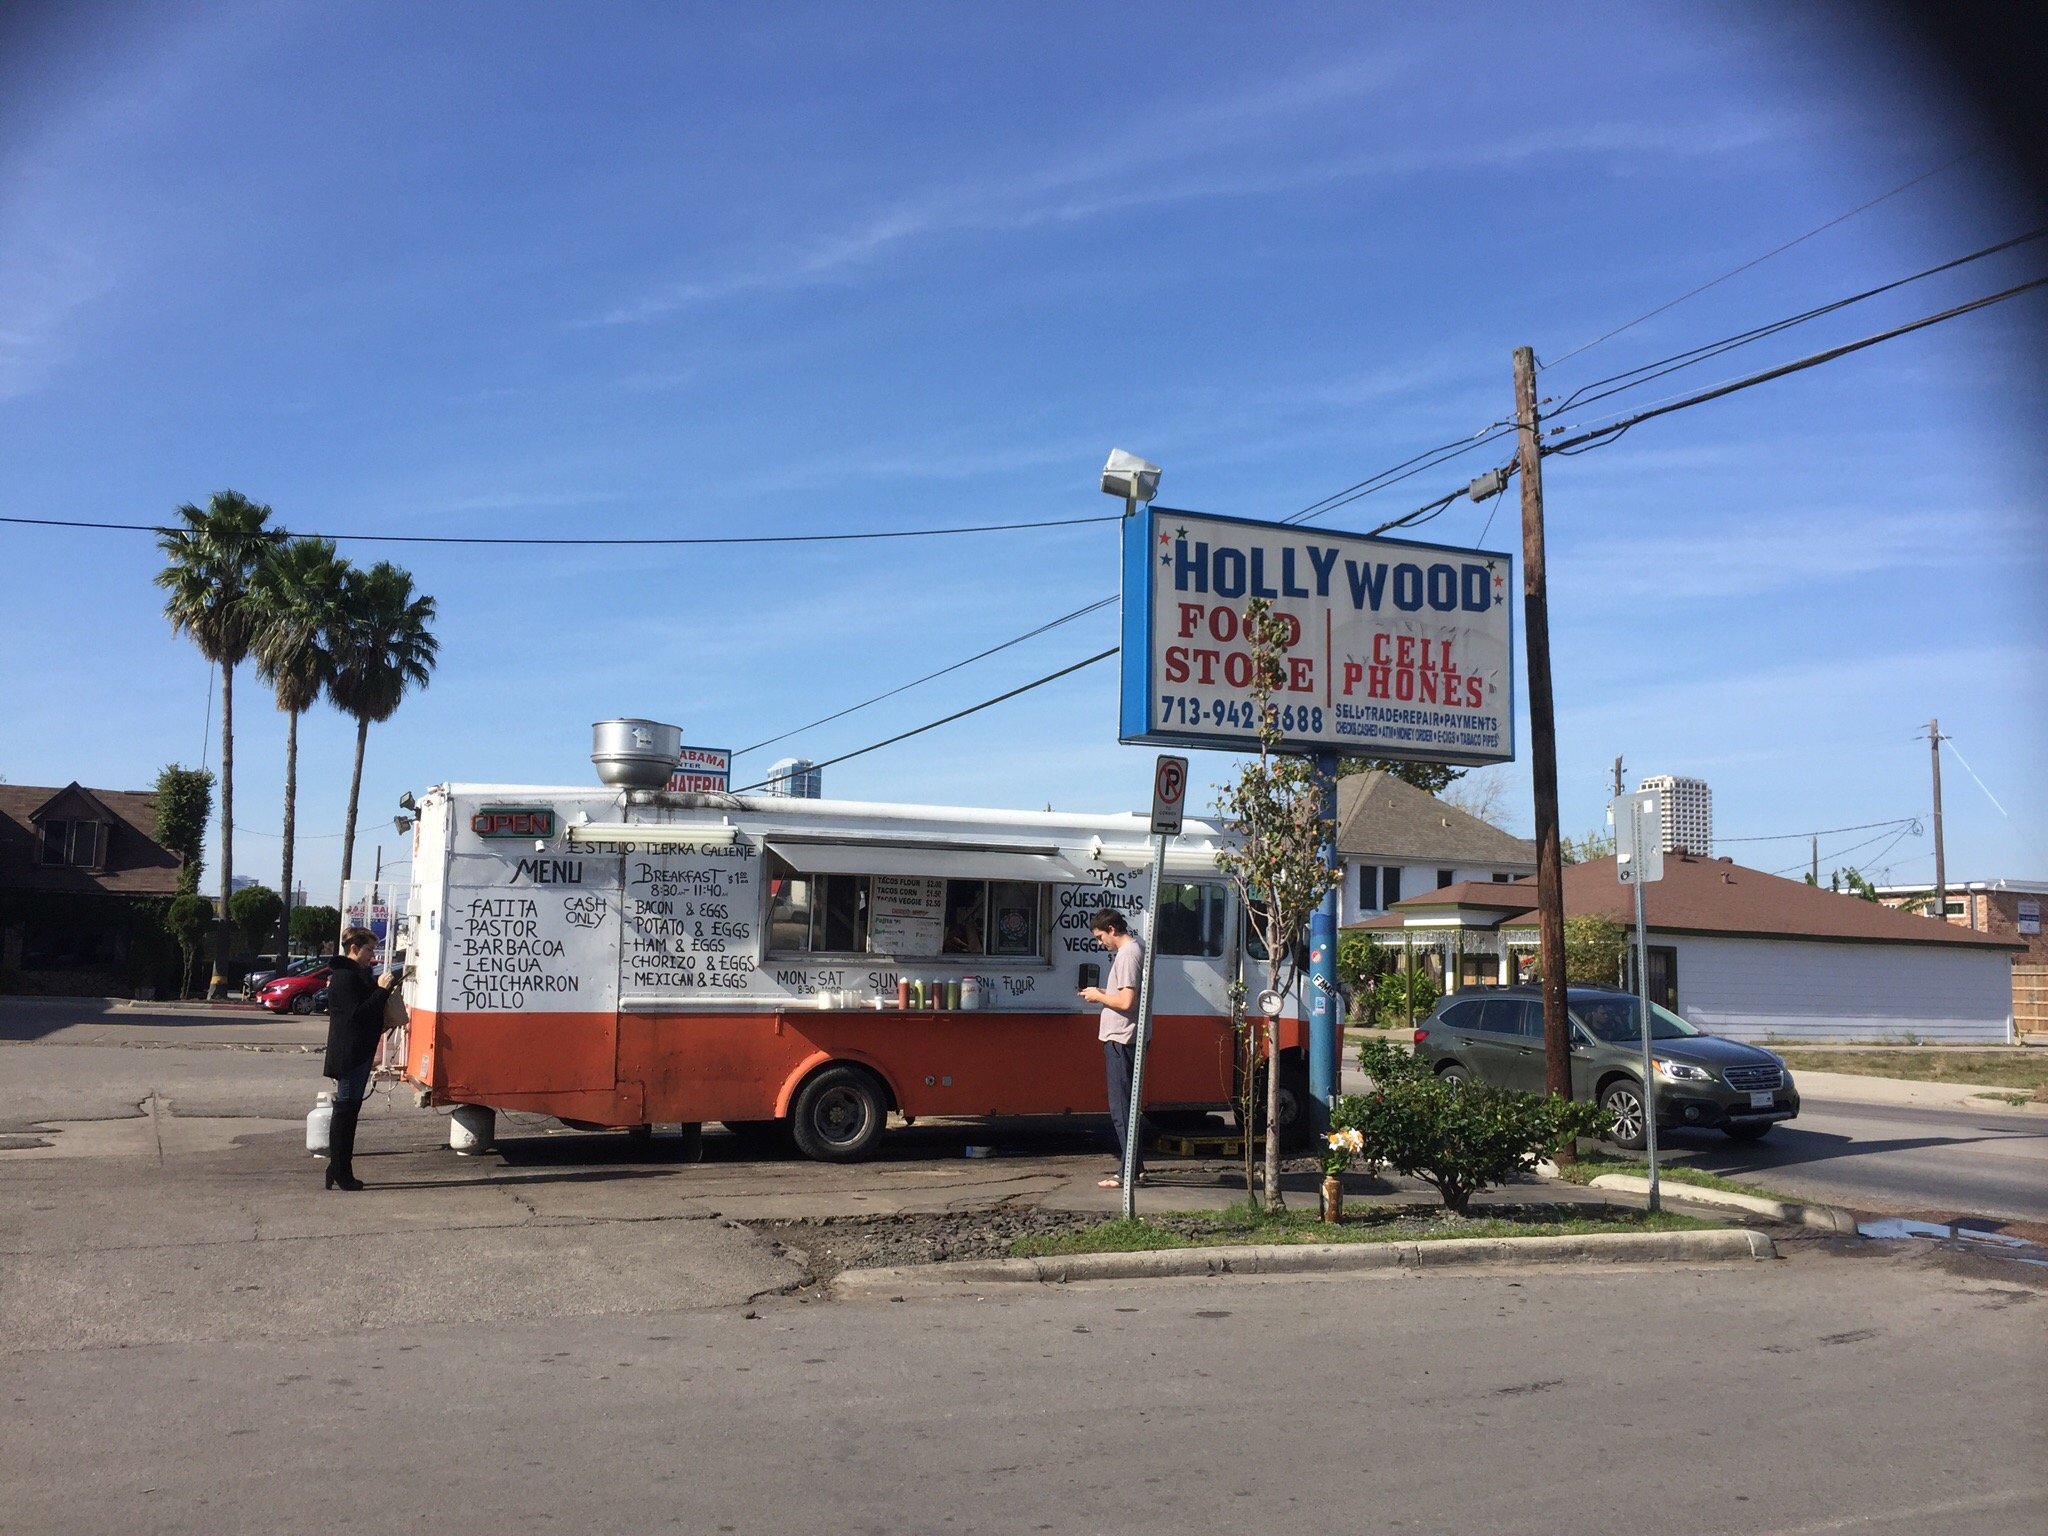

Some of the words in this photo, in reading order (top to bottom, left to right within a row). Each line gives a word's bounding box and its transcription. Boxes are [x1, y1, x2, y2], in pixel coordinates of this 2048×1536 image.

[1175, 539, 1491, 613] HOLLYWOOD
[1373, 633, 1457, 674] CELL
[1343, 662, 1483, 709] PHONES
[1335, 703, 1361, 719] SELL
[1365, 706, 1399, 723] TRADE
[1402, 709, 1439, 727] REPAIR
[1444, 713, 1497, 731] PAYMENTS
[664, 774, 724, 792] HATERIA
[471, 813, 549, 834] OPEN
[646, 842, 696, 856] TIERRA
[701, 843, 757, 861] CALIENTE
[509, 858, 583, 884] MENU
[631, 863, 727, 885] BREAKFAST
[563, 897, 607, 913] CASH
[635, 900, 673, 916] BACON
[699, 903, 729, 919] EGGS
[1060, 890, 1144, 910] QUESADILLAS
[465, 919, 538, 938] PASTOR
[566, 912, 607, 929] ONLY
[633, 916, 684, 936] POTATO
[711, 922, 750, 939] EGGS
[462, 938, 566, 957] BARBACOA
[633, 938, 667, 953] HAM
[691, 938, 726, 953] EGGS
[465, 957, 543, 973] LENGUA
[631, 955, 696, 969] CHORIZO
[718, 955, 756, 973] EGGS
[462, 974, 579, 992] CHICHARRON
[634, 972, 694, 987] MEXICAN
[710, 972, 748, 989] EGGS
[868, 972, 898, 988] SUN
[1002, 975, 1036, 991] FLOUR
[460, 991, 524, 1011] POLLO
